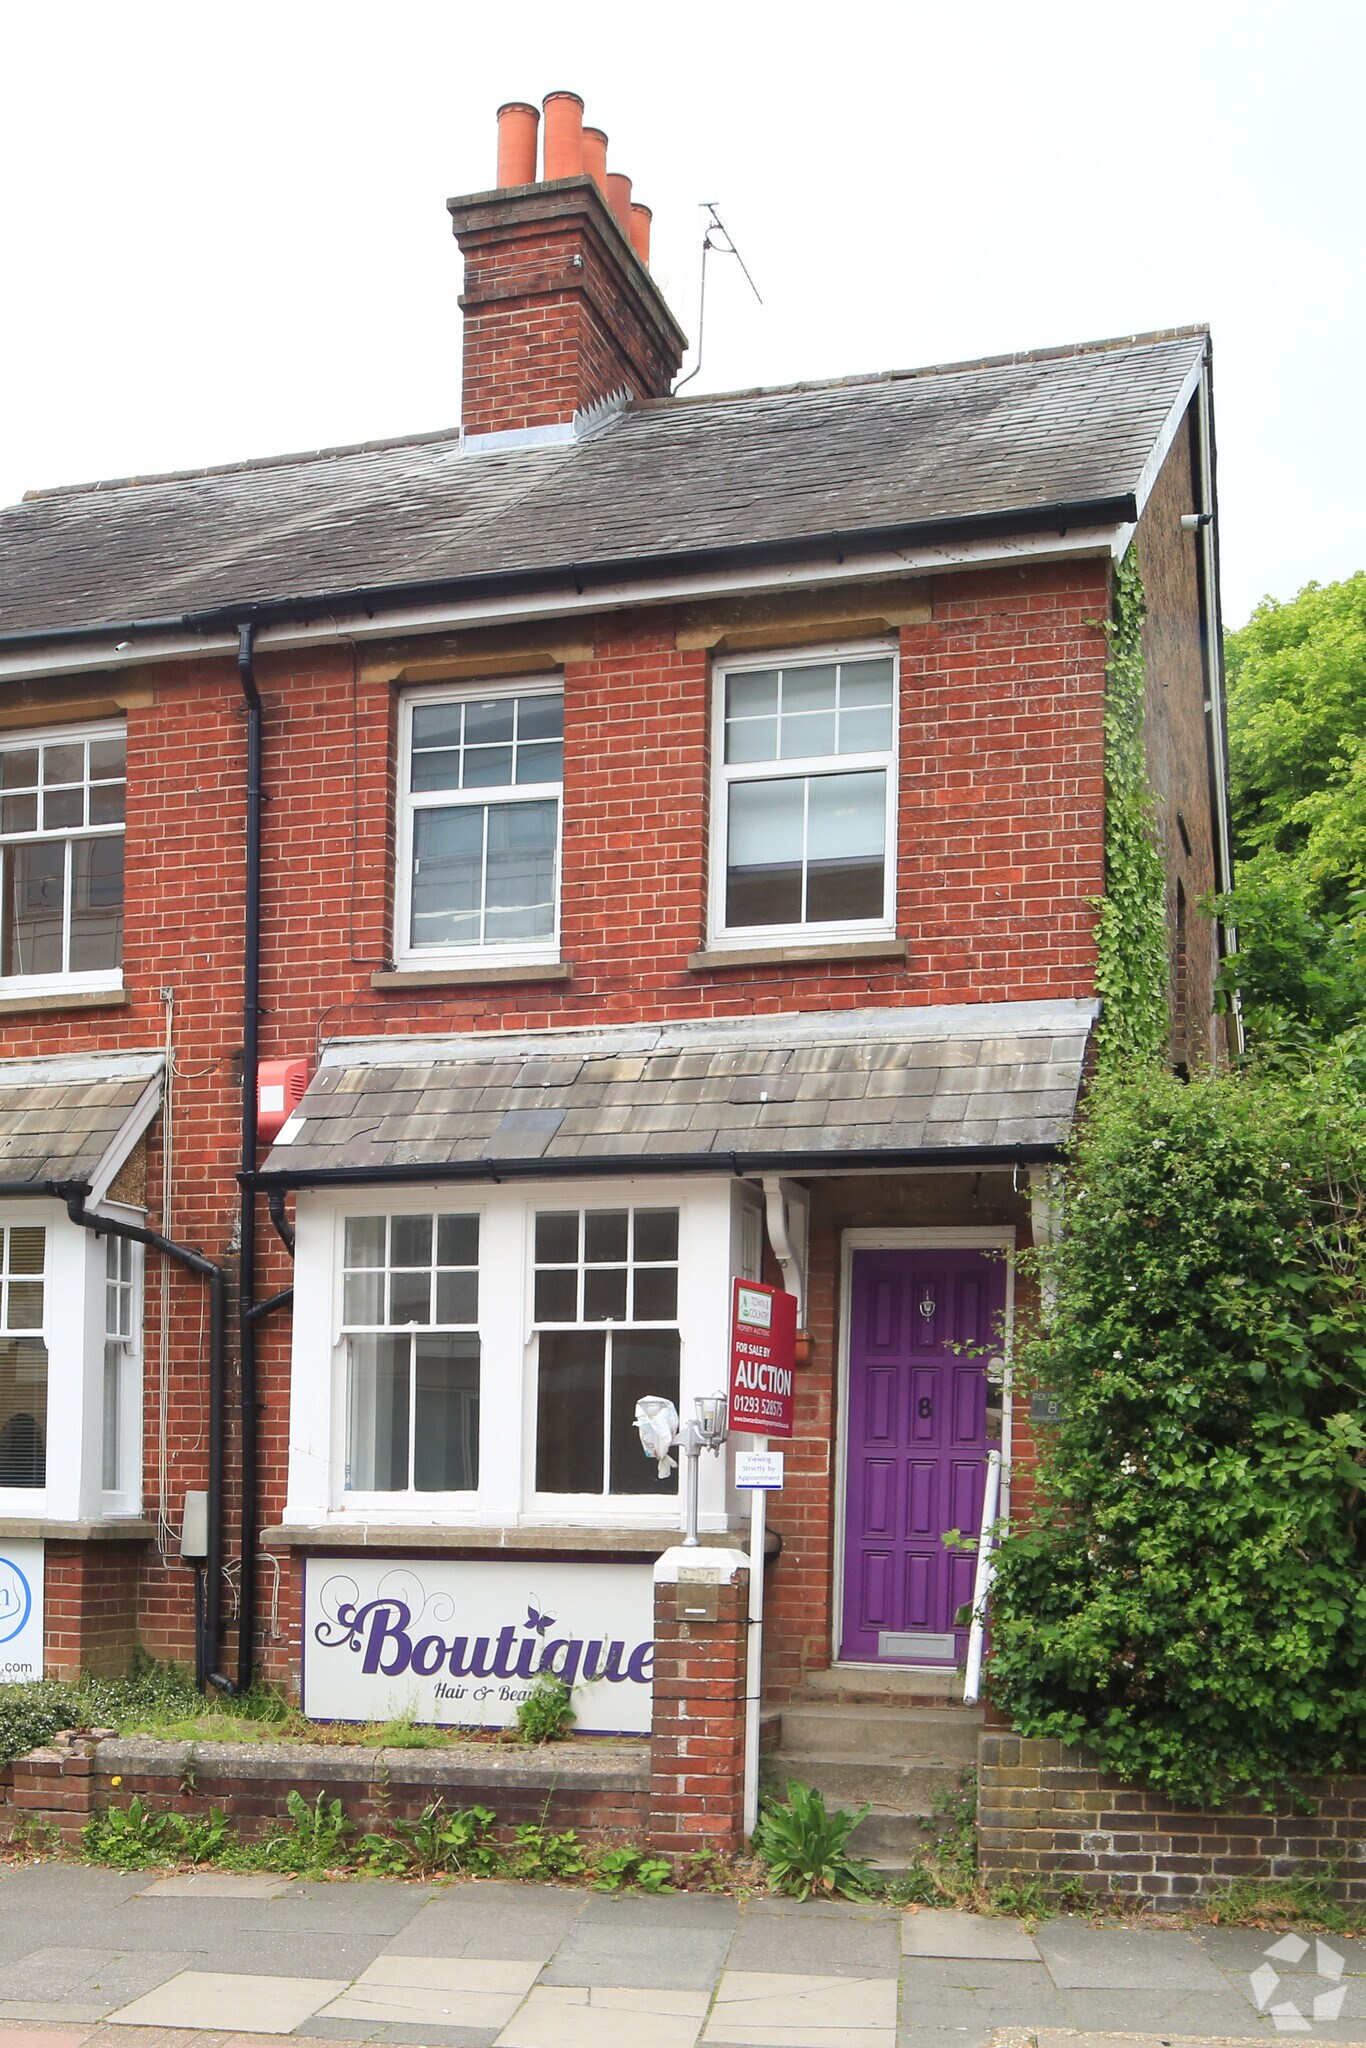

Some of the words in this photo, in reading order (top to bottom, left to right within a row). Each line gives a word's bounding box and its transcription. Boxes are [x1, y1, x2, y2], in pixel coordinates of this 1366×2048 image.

[736, 1341, 748, 1354] FOR
[748, 1344, 763, 1357] SALE
[763, 1347, 771, 1358] BY
[734, 1360, 792, 1397] AUCTION
[734, 1394, 760, 1414] 01293
[761, 1398, 783, 1417] 528575
[918, 1397, 932, 1419] 8
[737, 1474, 780, 1482] Appointment
[742, 1465, 765, 1473] Strictly
[767, 1465, 776, 1473] by
[315, 1598, 655, 1699] Boutique
[433, 1682, 469, 1699] Hair
[473, 1685, 495, 1701] &
